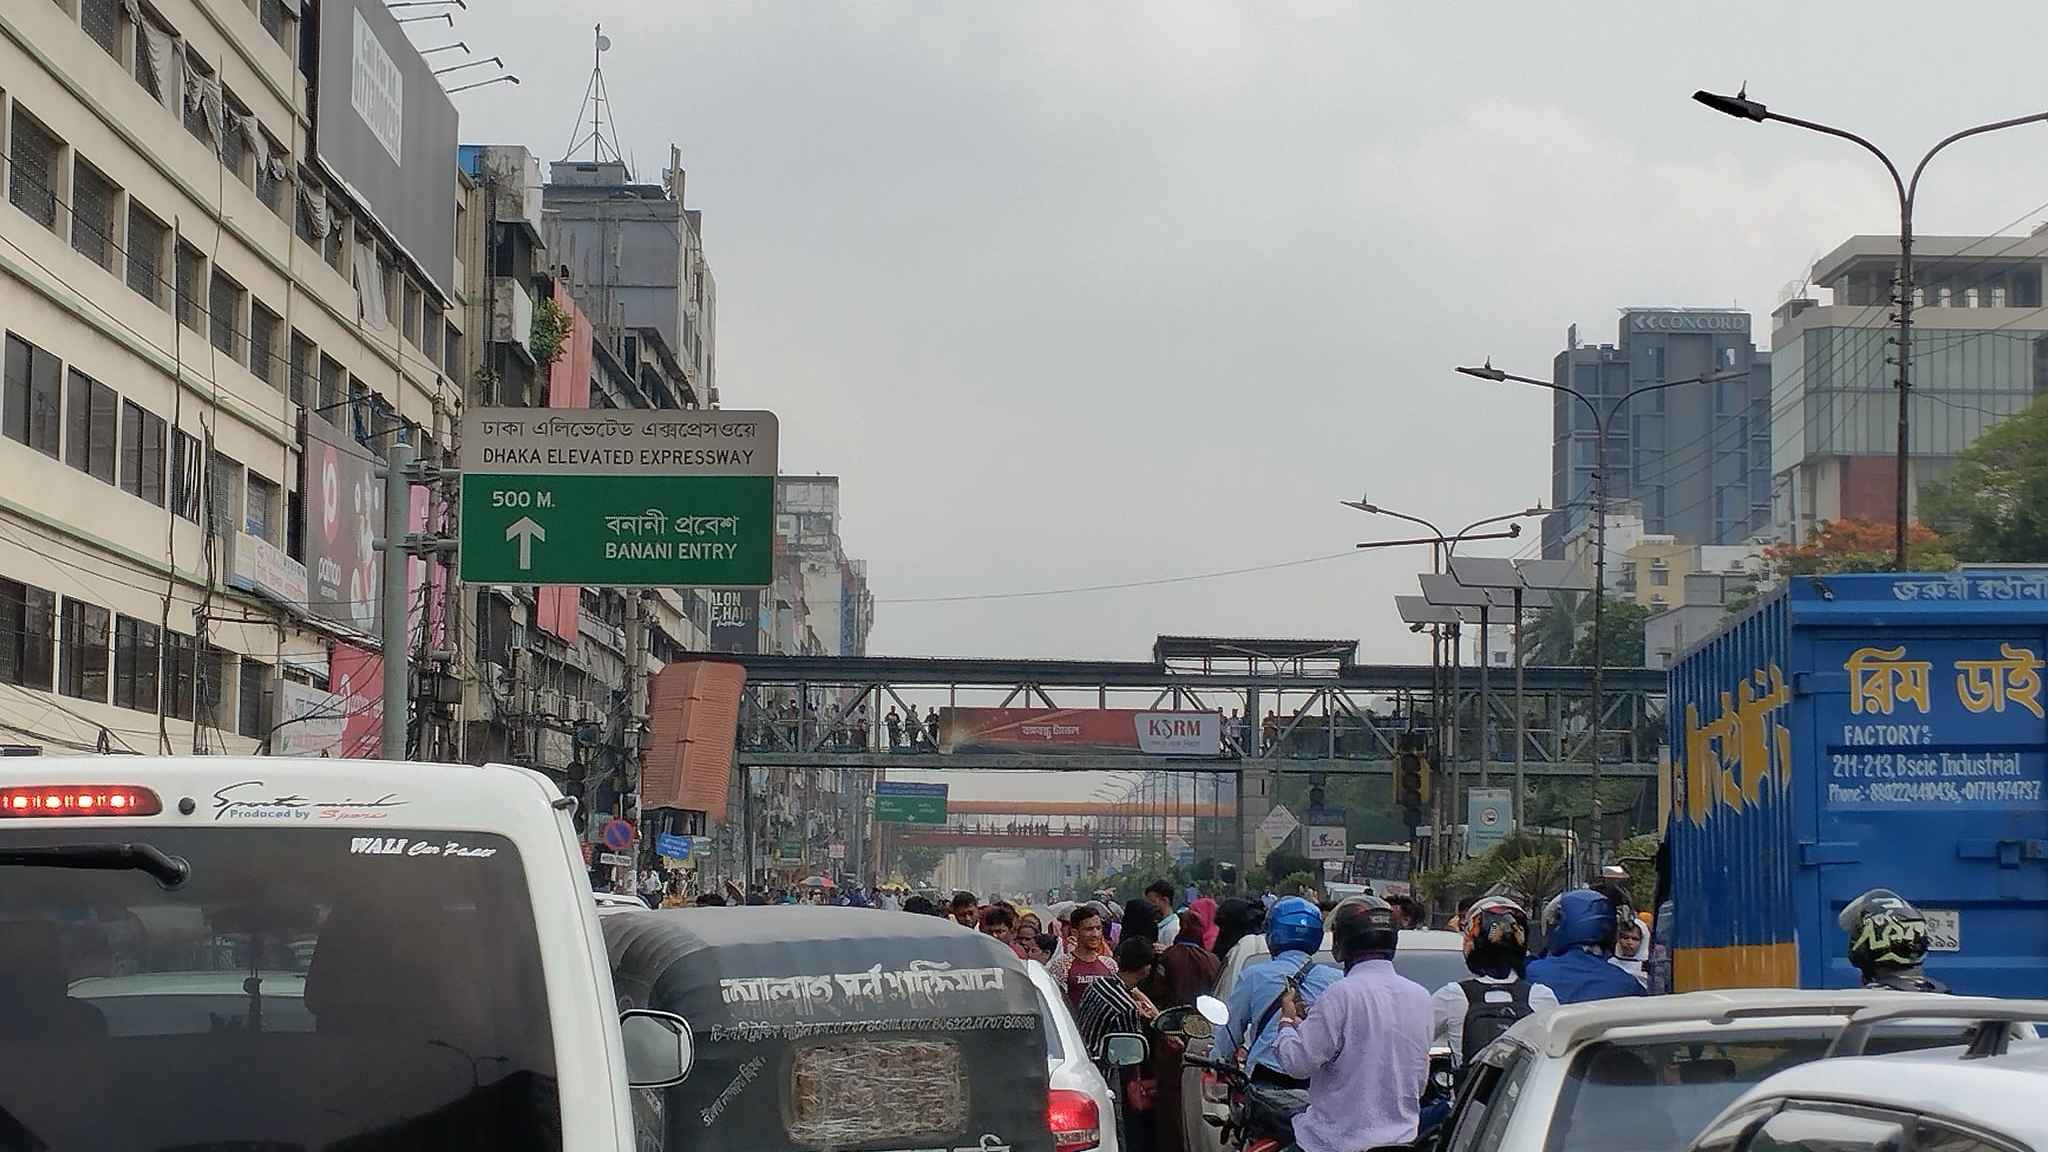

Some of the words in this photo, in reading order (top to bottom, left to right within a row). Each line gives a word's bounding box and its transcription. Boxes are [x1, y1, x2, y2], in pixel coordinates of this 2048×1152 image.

[1658, 315, 1746, 330] CONCORD
[481, 420, 525, 438] ঢাকা
[532, 416, 635, 438] এলিভেটেড
[483, 447, 541, 465] DHAKA
[548, 448, 634, 466] ELEVATED
[640, 449, 754, 466] EXPRESSWAY
[492, 491, 530, 508] 500
[536, 491, 556, 508] M.
[604, 509, 669, 536] বনানী
[673, 515, 740, 537] প্রবেশ
[605, 543, 673, 560] BANANI
[678, 543, 738, 560] ENTRY
[1892, 577, 1968, 601] জরুরী
[1843, 645, 1933, 715] রিম
[1149, 719, 1201, 740] KSRM
[1939, 752, 2021, 777] Industrial
[230, 809, 291, 820] Produced
[294, 809, 310, 821] by
[350, 837, 408, 855] WALI
